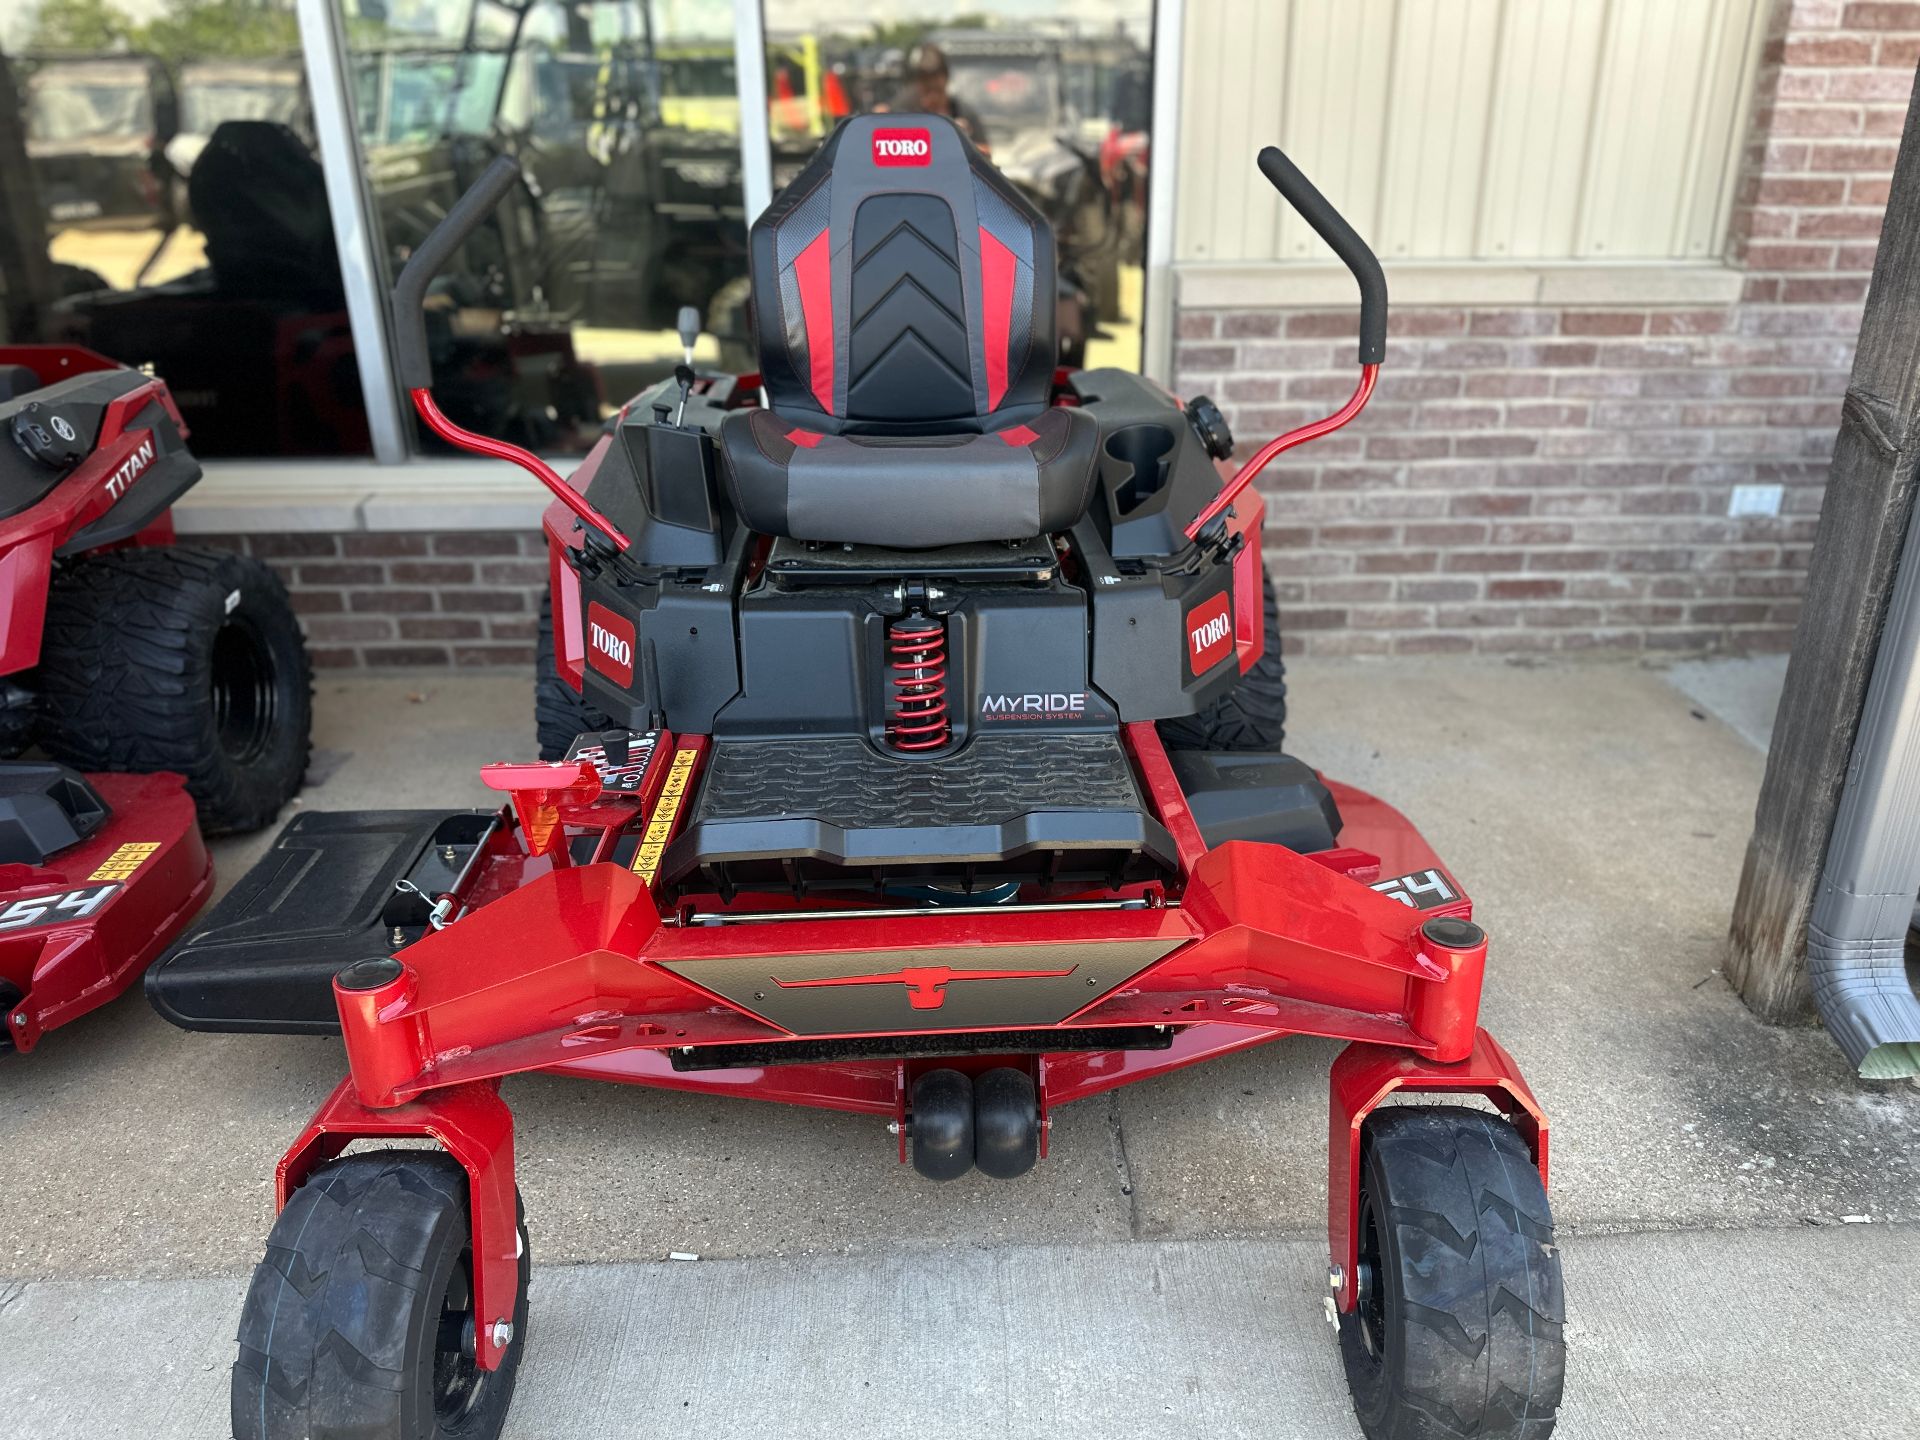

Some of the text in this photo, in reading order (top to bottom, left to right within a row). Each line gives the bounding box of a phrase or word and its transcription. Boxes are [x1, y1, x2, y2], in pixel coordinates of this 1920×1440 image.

[876, 139, 928, 156] TORO
[105, 440, 154, 500] TITAN
[590, 622, 631, 666] TORO
[1191, 612, 1229, 654] TORO
[985, 713, 1043, 721] SUSPENSION
[0, 884, 118, 929] 54
